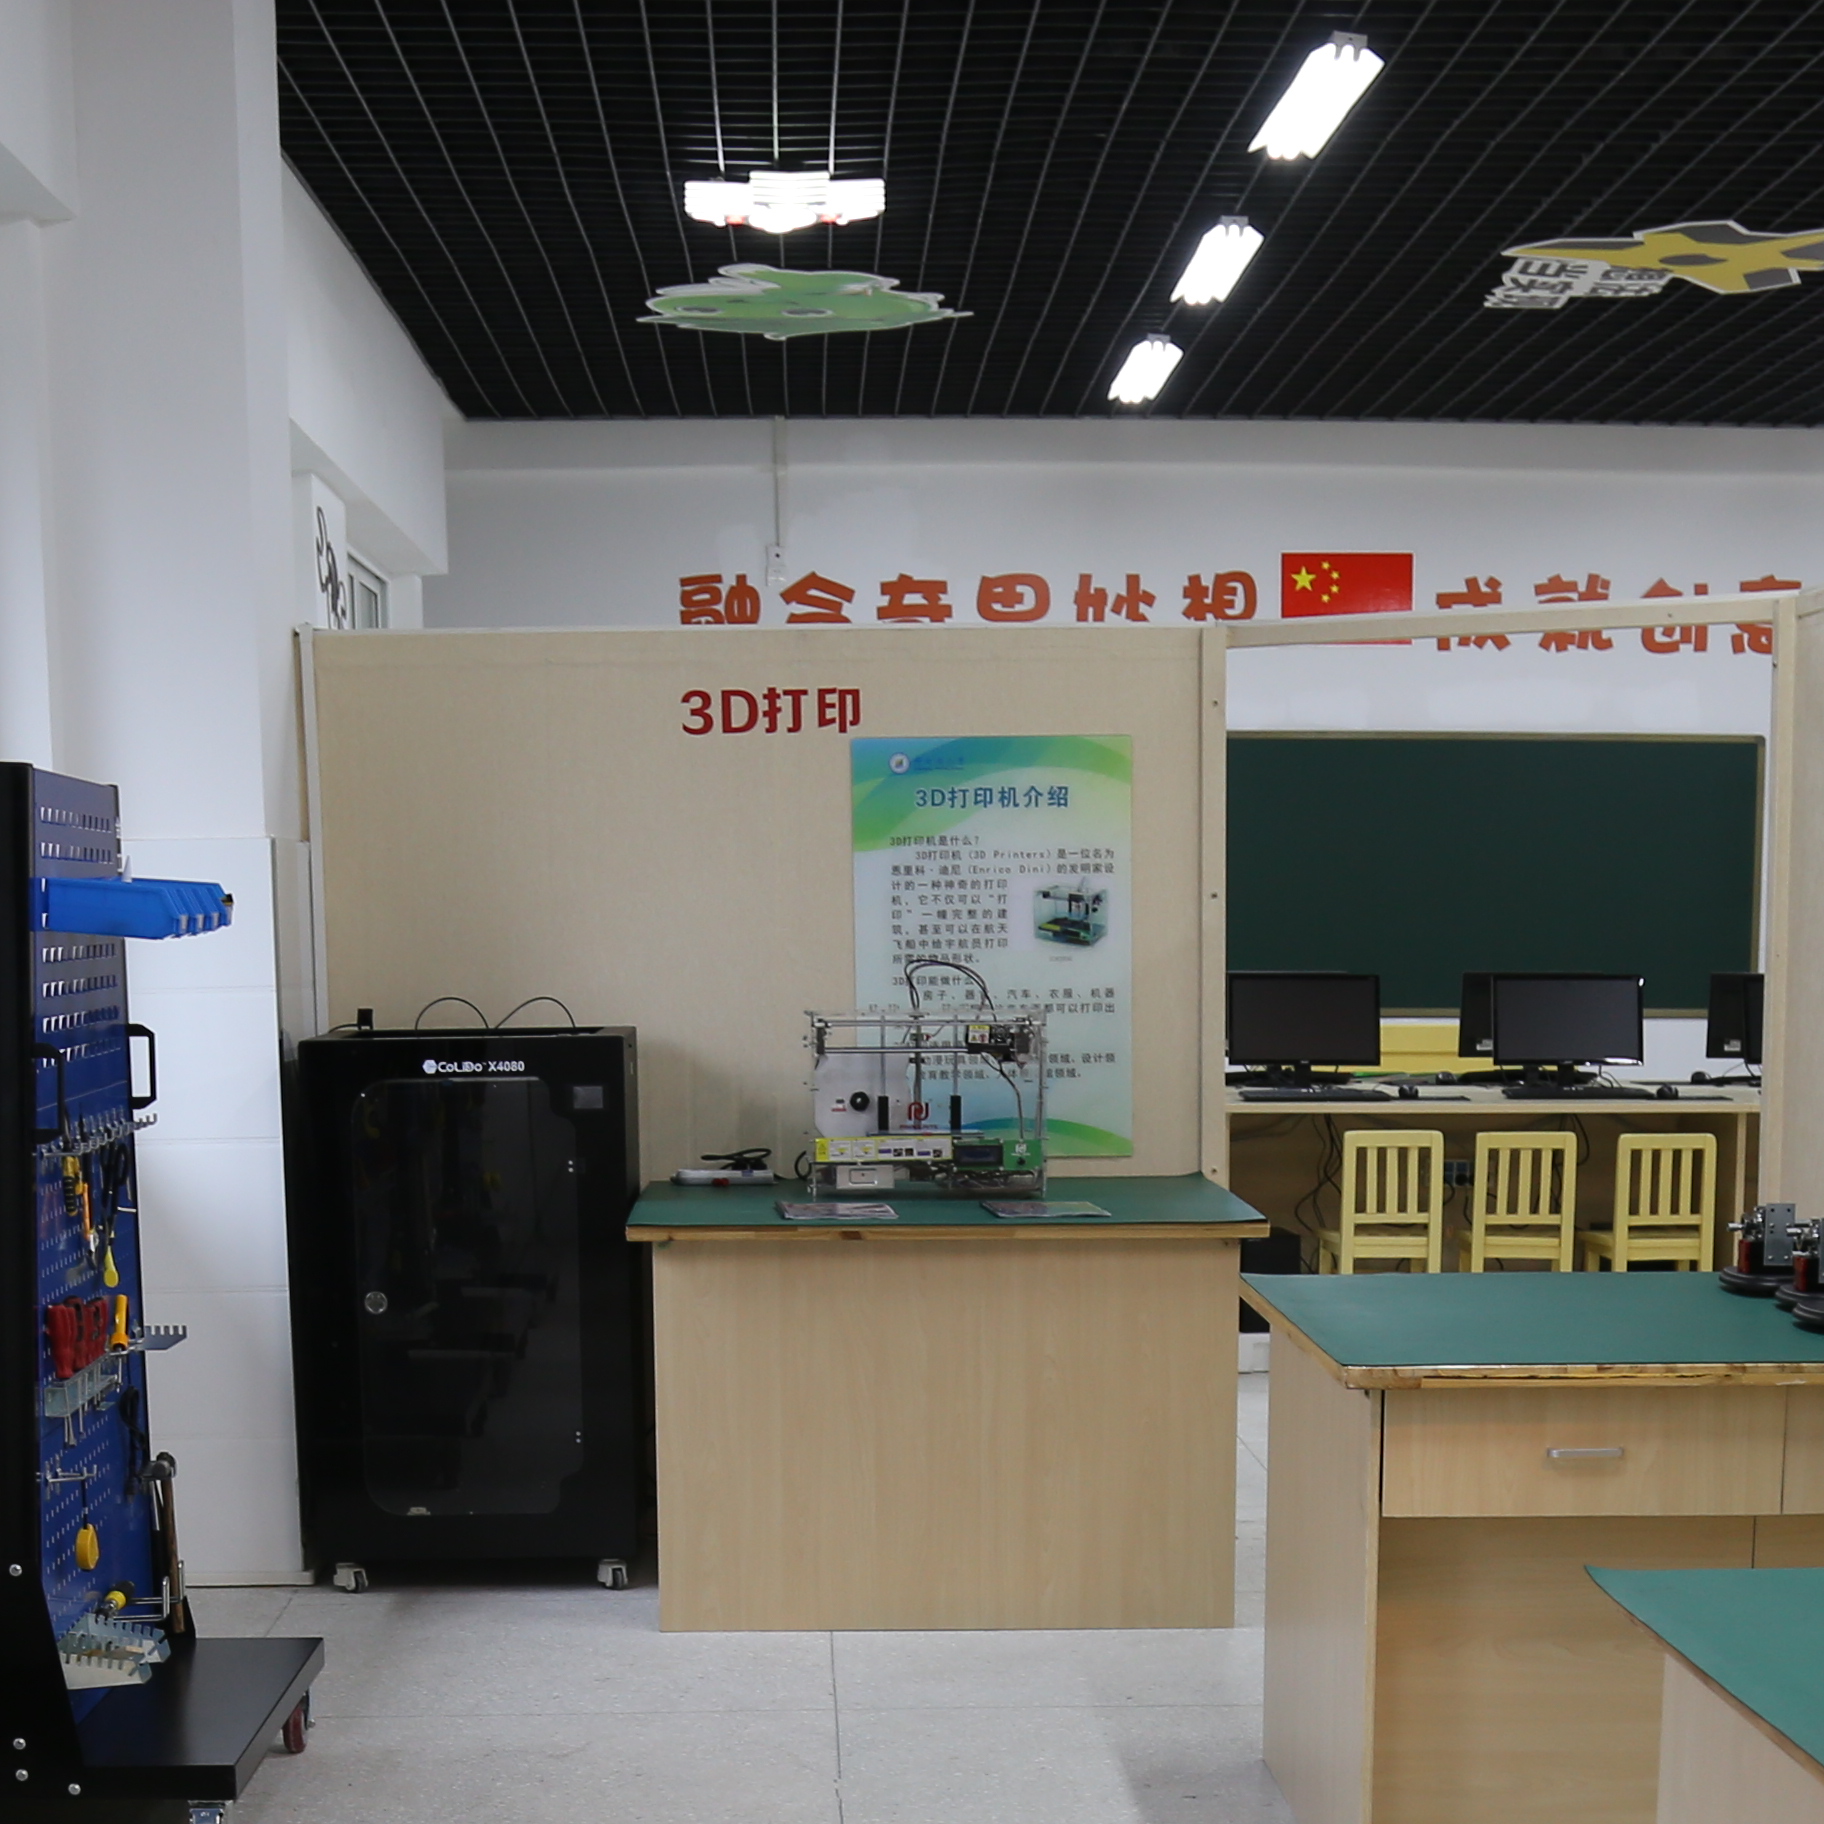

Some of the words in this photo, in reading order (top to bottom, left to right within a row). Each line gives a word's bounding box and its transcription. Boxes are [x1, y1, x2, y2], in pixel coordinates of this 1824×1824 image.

[680, 687, 862, 735] 3D打印
[915, 786, 1069, 808] 3D打印机介绍
[488, 1061, 525, 1072] X4080
